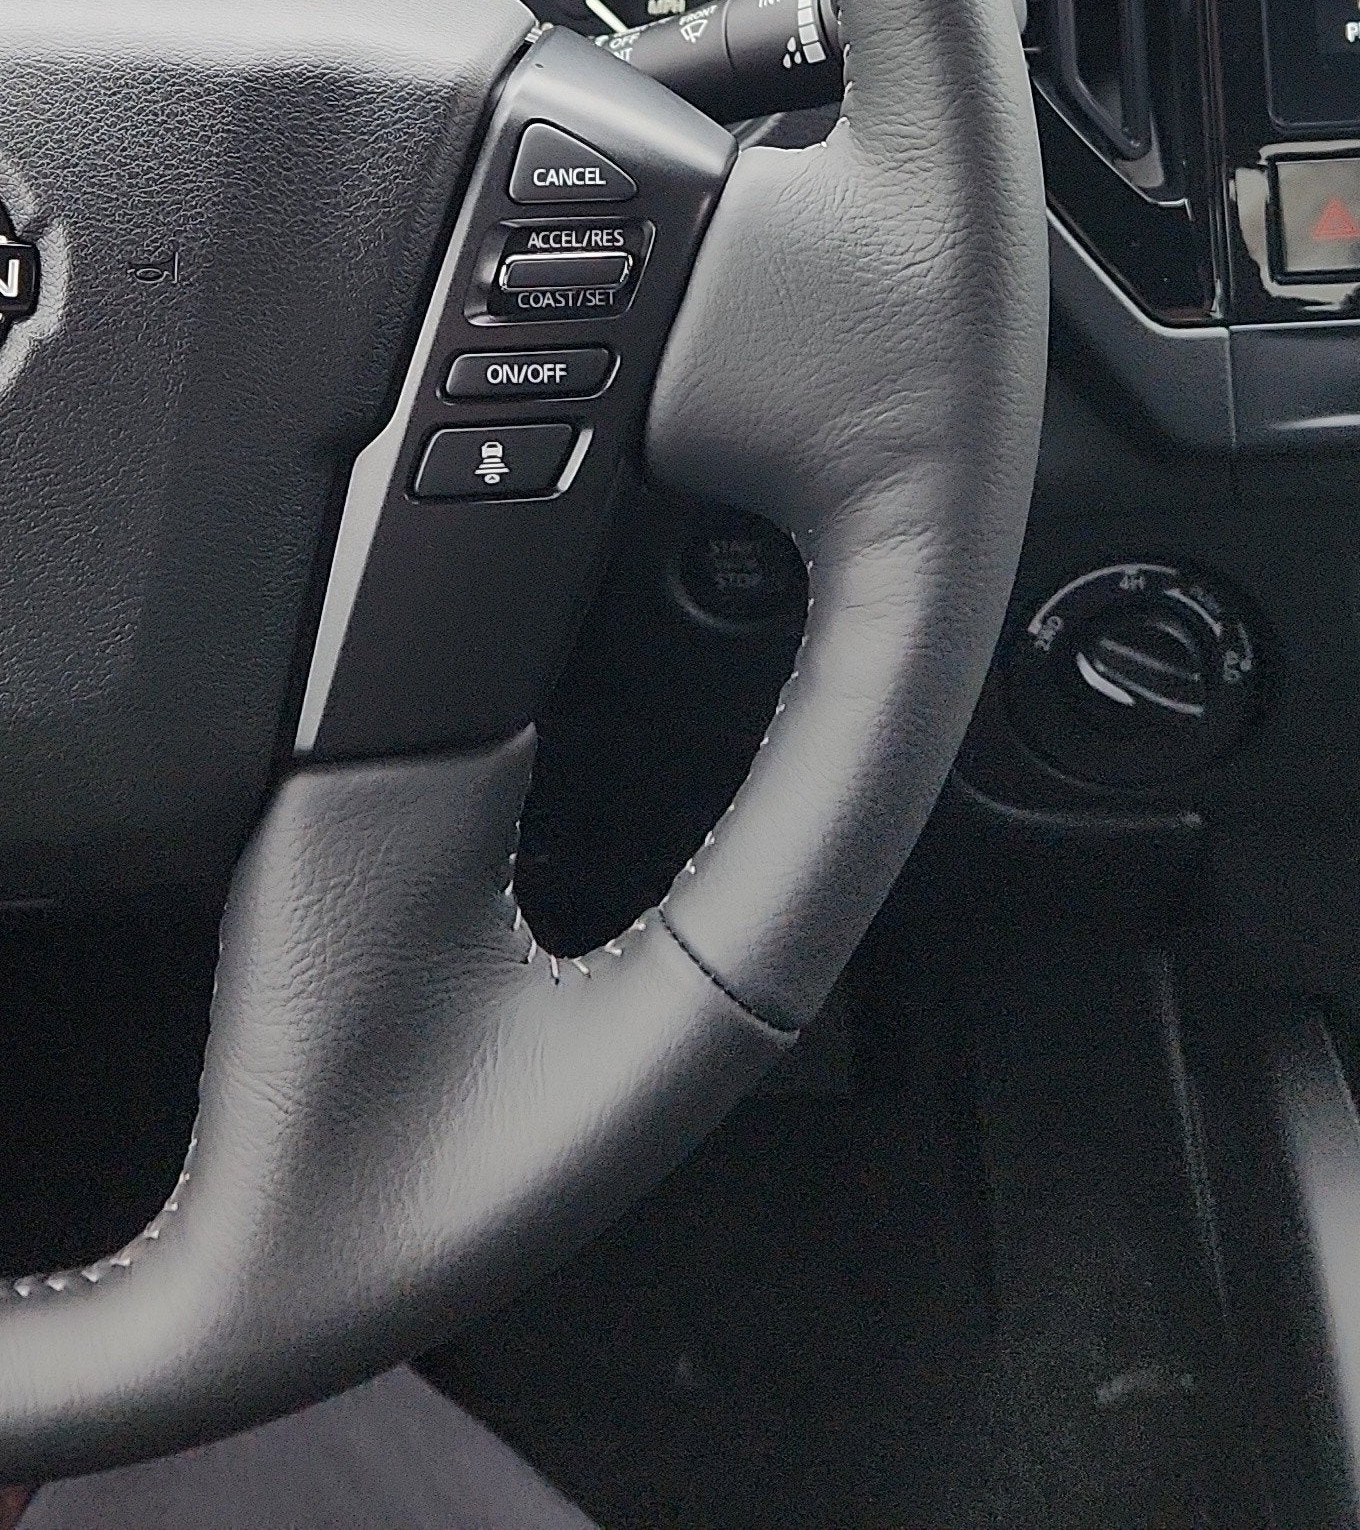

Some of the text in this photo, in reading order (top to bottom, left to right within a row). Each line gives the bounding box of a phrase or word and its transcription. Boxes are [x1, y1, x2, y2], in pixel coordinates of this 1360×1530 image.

[679, 5, 717, 25] FRONT
[609, 32, 640, 49] OFF
[533, 167, 606, 187] CANCEL
[527, 229, 624, 249] ACCEL/RES
[517, 288, 614, 309] COAST/SET
[487, 363, 567, 384] ON/OFF
